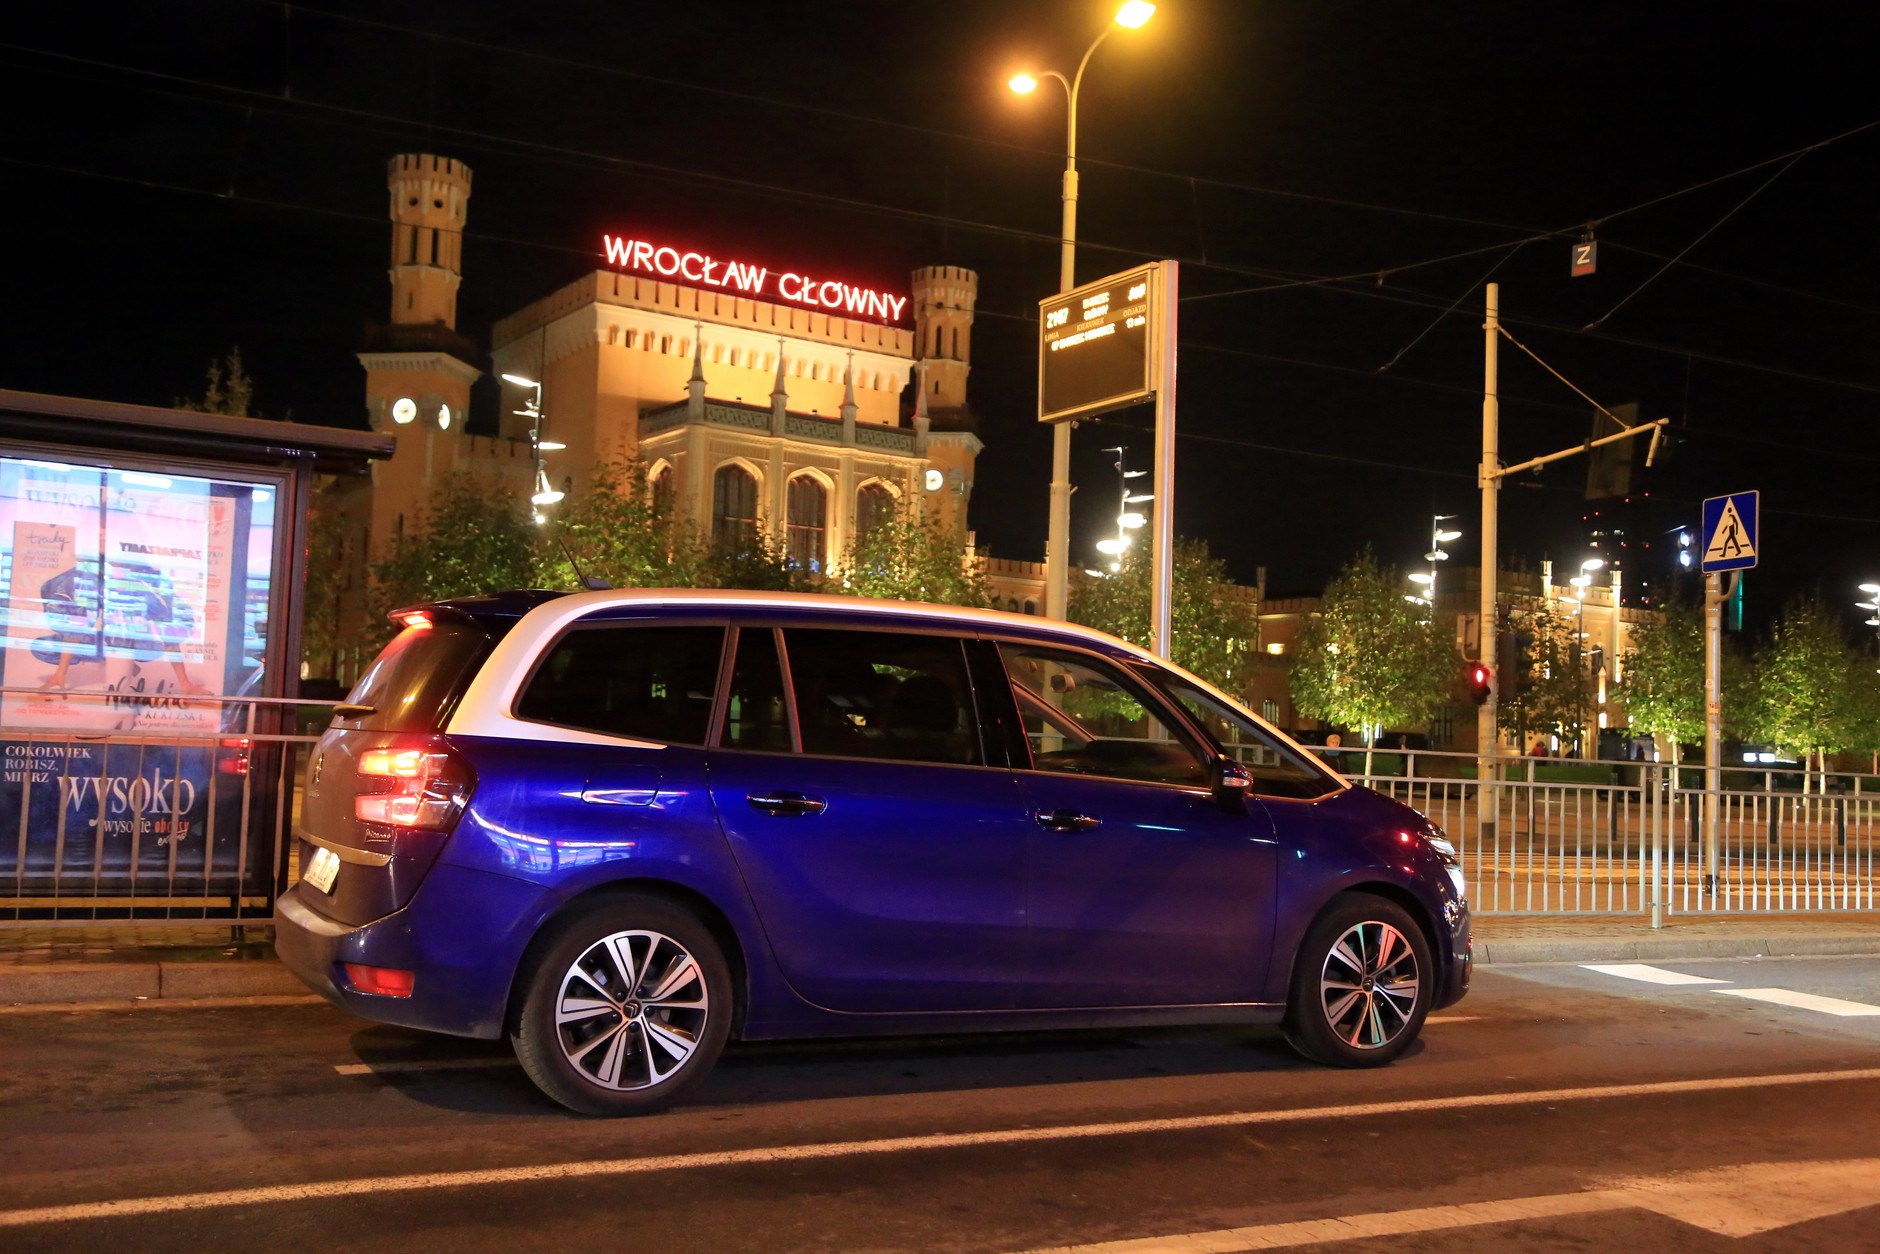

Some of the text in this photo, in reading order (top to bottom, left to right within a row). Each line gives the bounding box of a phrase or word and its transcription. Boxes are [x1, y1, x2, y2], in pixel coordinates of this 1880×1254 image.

[1576, 245, 1591, 265] Z
[603, 233, 907, 321] WROCŁAW GŁÓWNY
[1122, 304, 1147, 317] ODJAZD
[1076, 317, 1105, 332] KIERUNEK
[1044, 331, 1060, 342] LINIA
[5, 746, 91, 759] COKOLWIEK
[5, 758, 59, 771] ROBISZ,
[104, 818, 152, 837] wysoie
